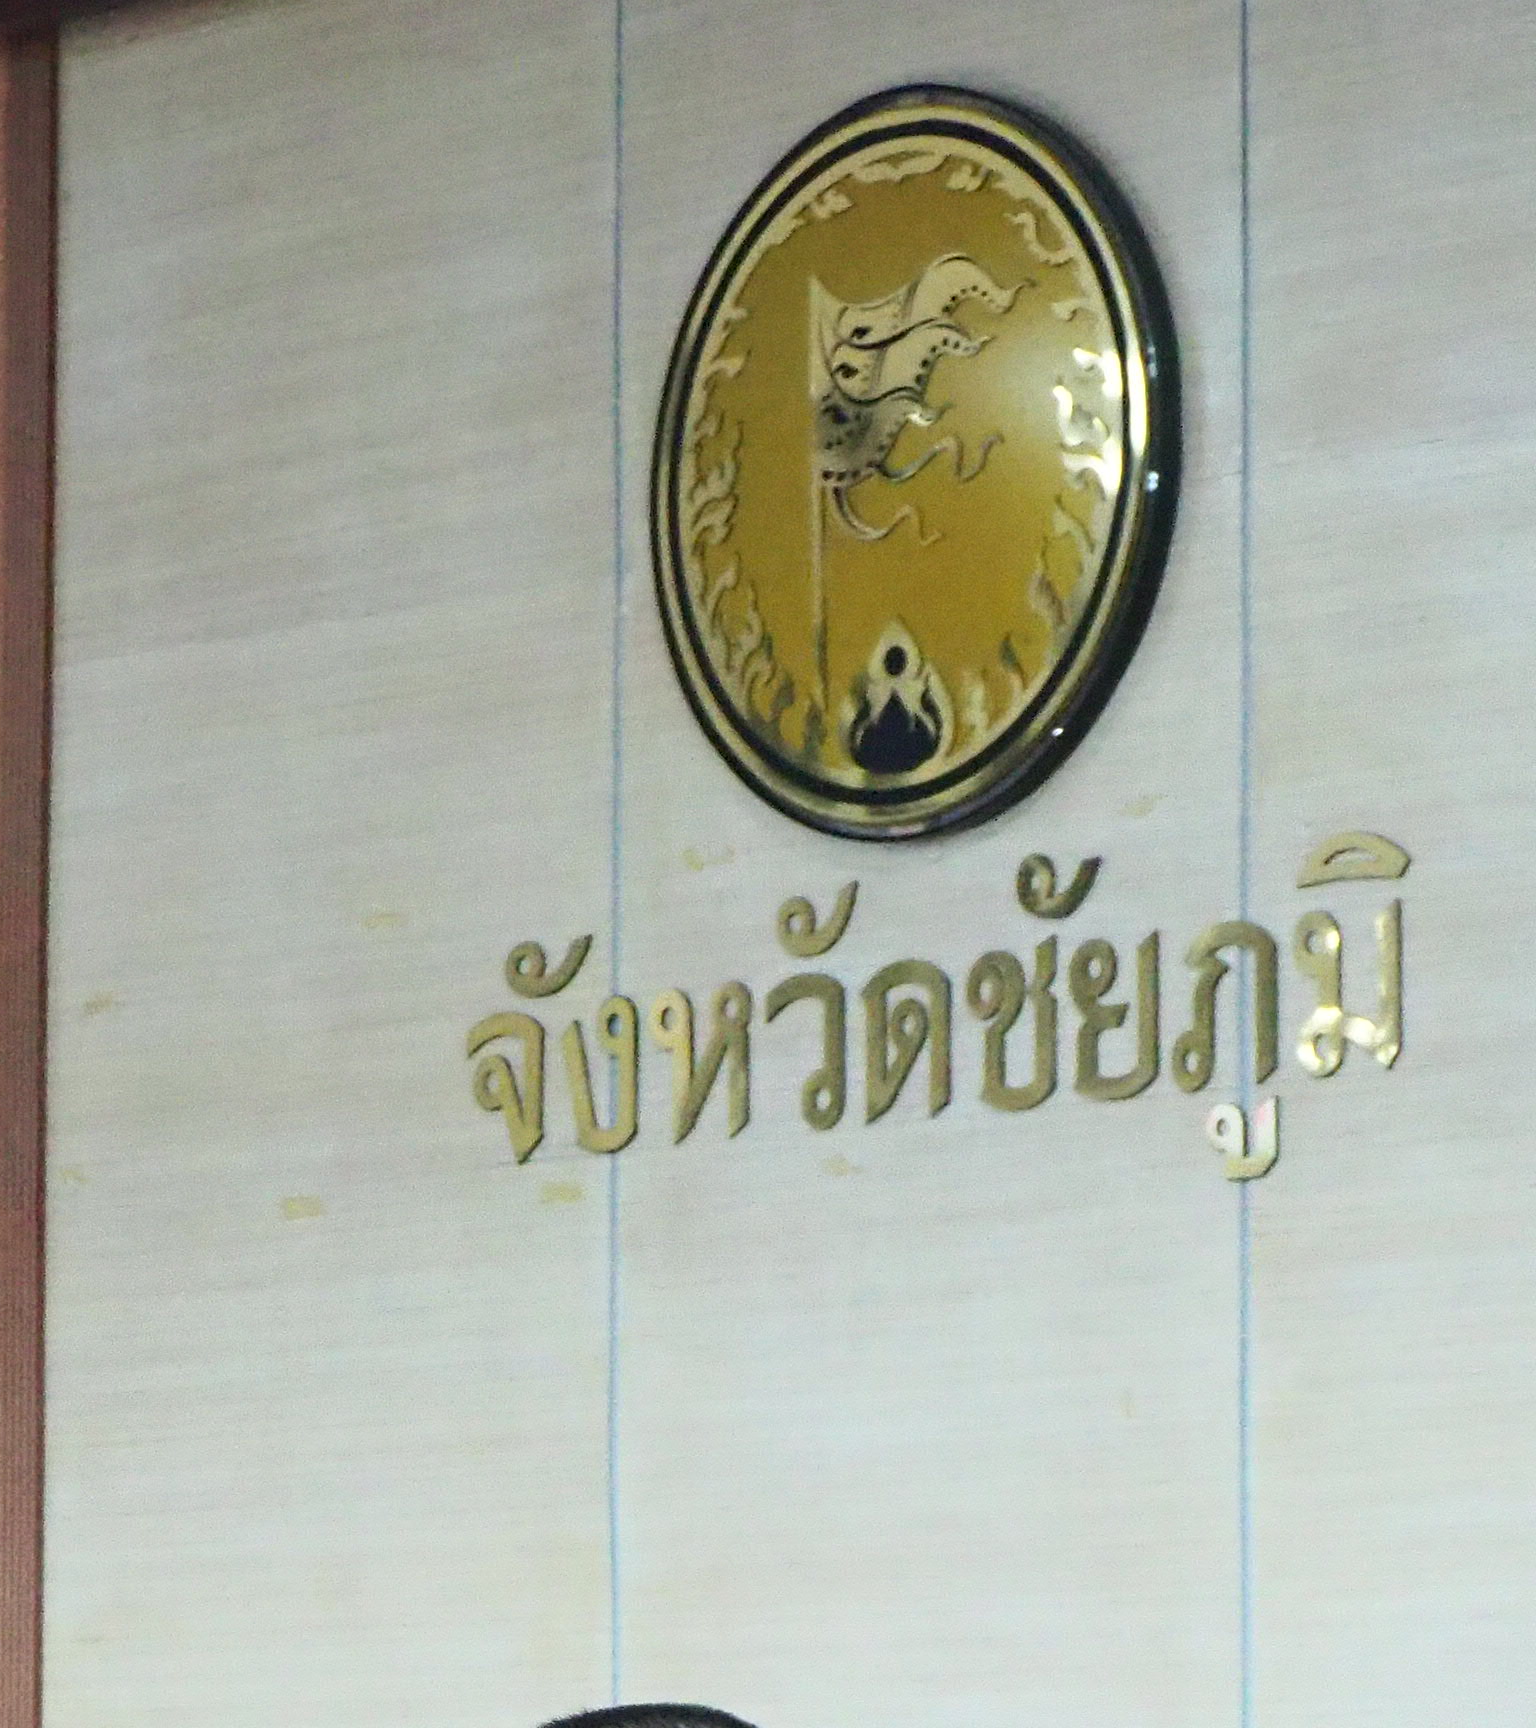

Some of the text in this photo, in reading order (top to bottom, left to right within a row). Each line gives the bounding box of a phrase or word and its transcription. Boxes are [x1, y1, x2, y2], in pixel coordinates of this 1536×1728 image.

[467, 831, 1411, 1181] จังหวัดชัยภูมิ
